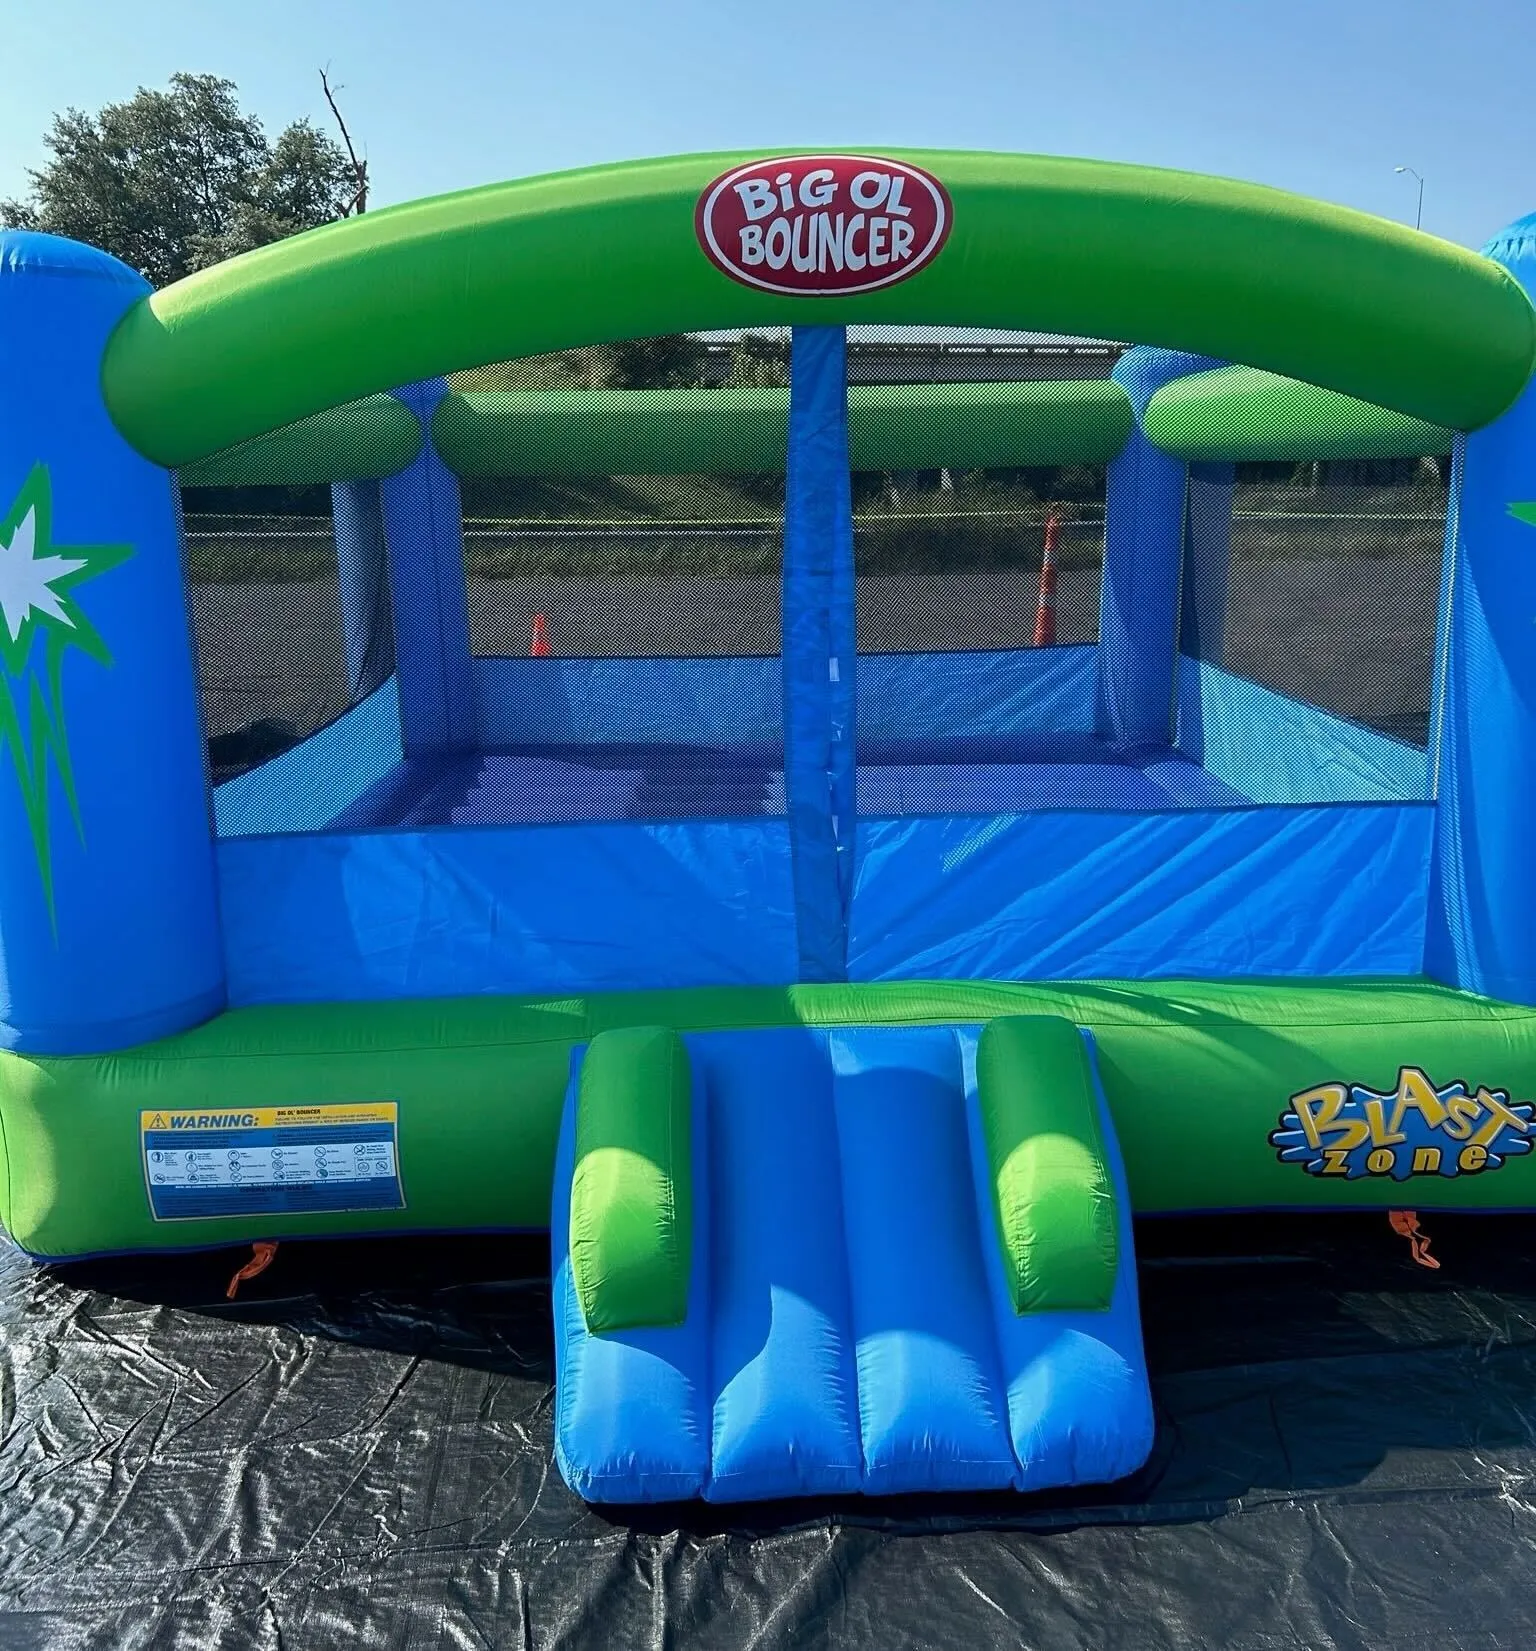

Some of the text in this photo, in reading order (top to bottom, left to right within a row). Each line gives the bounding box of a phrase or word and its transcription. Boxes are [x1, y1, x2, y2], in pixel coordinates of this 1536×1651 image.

[738, 212, 915, 274] BOUNCER
[170, 1113, 260, 1129] WARNING:
[1291, 1068, 1529, 1150] BLAST
